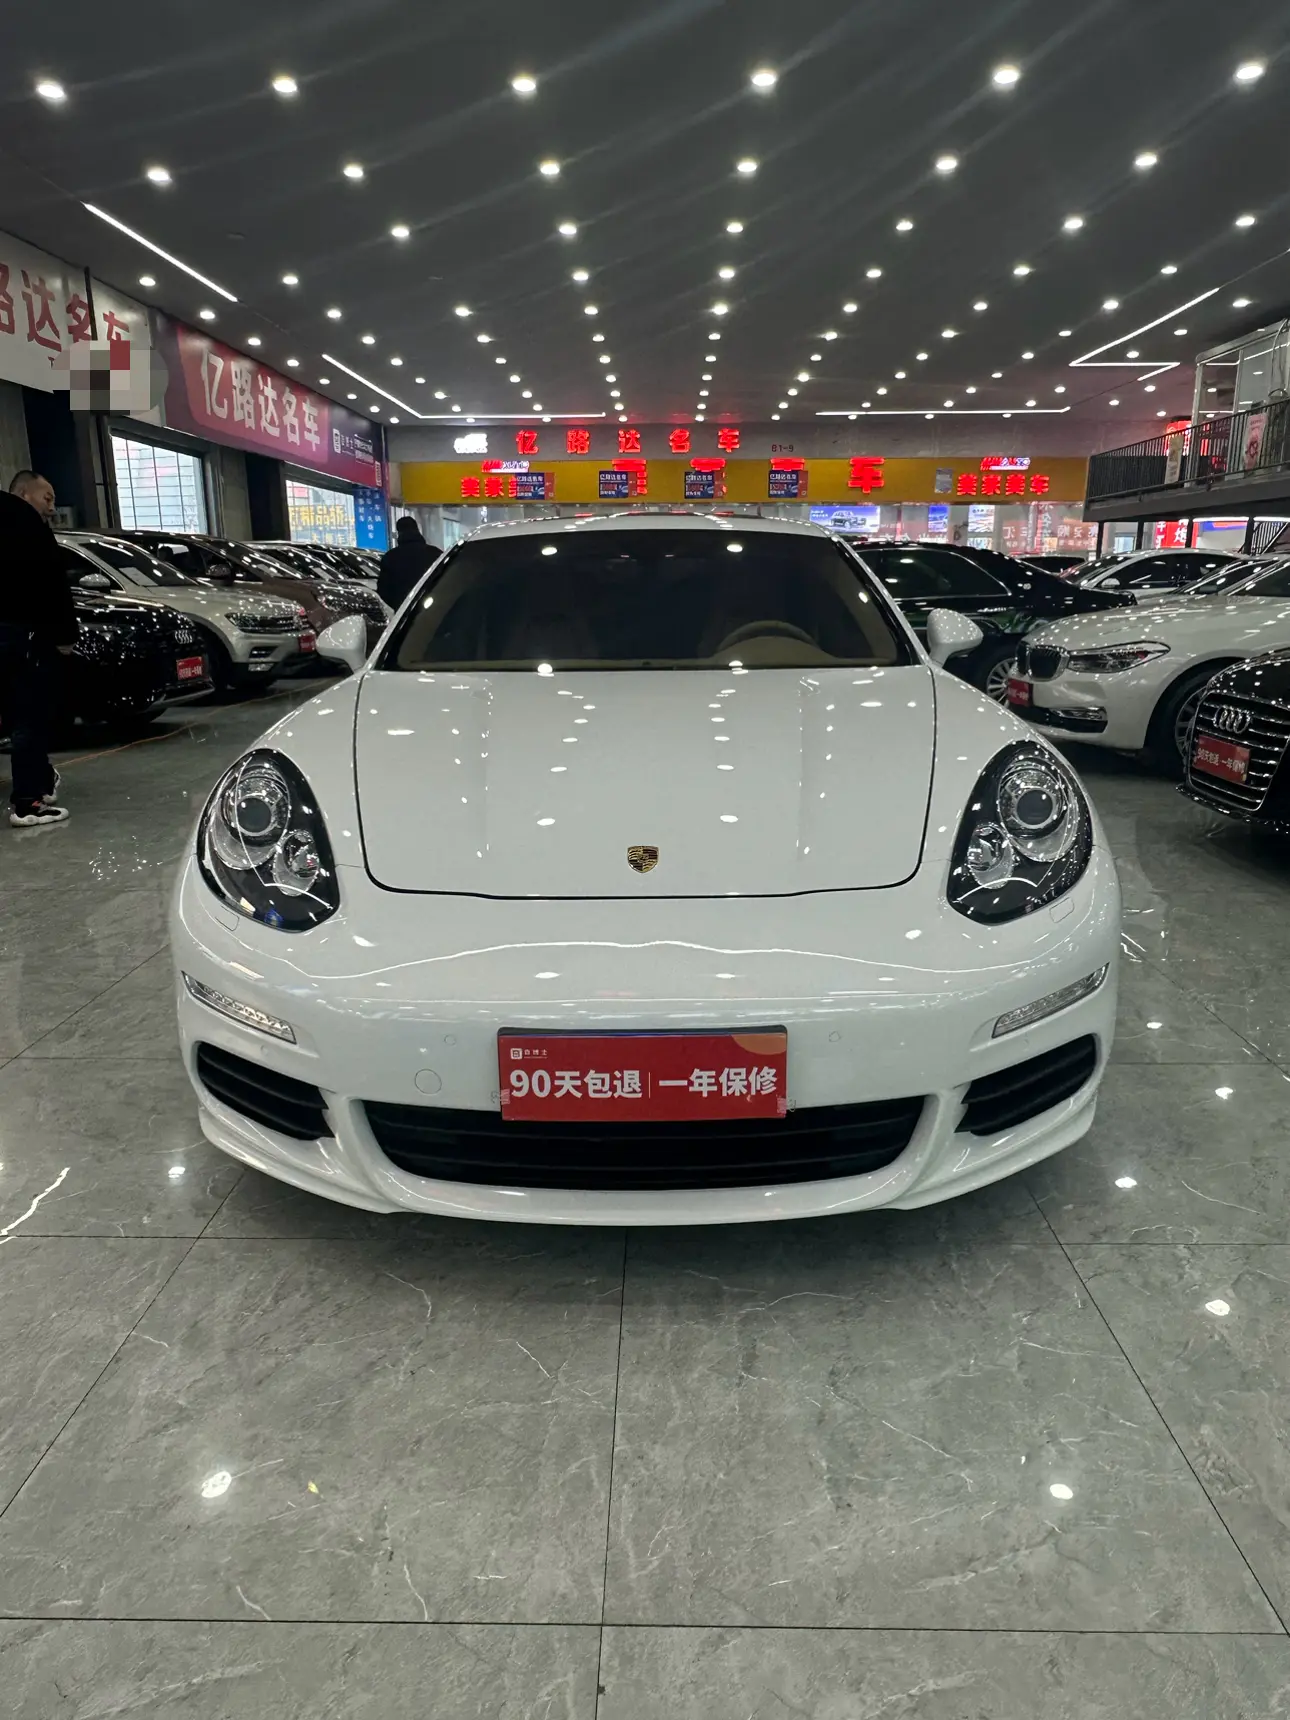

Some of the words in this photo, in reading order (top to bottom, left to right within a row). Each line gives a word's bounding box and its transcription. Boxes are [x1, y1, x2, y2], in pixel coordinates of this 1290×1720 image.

[201, 349, 321, 451] 亿路达名车
[515, 428, 740, 454] 亿路达名车
[509, 1069, 643, 1099] 90天包退
[658, 1066, 778, 1098] 一年保修
